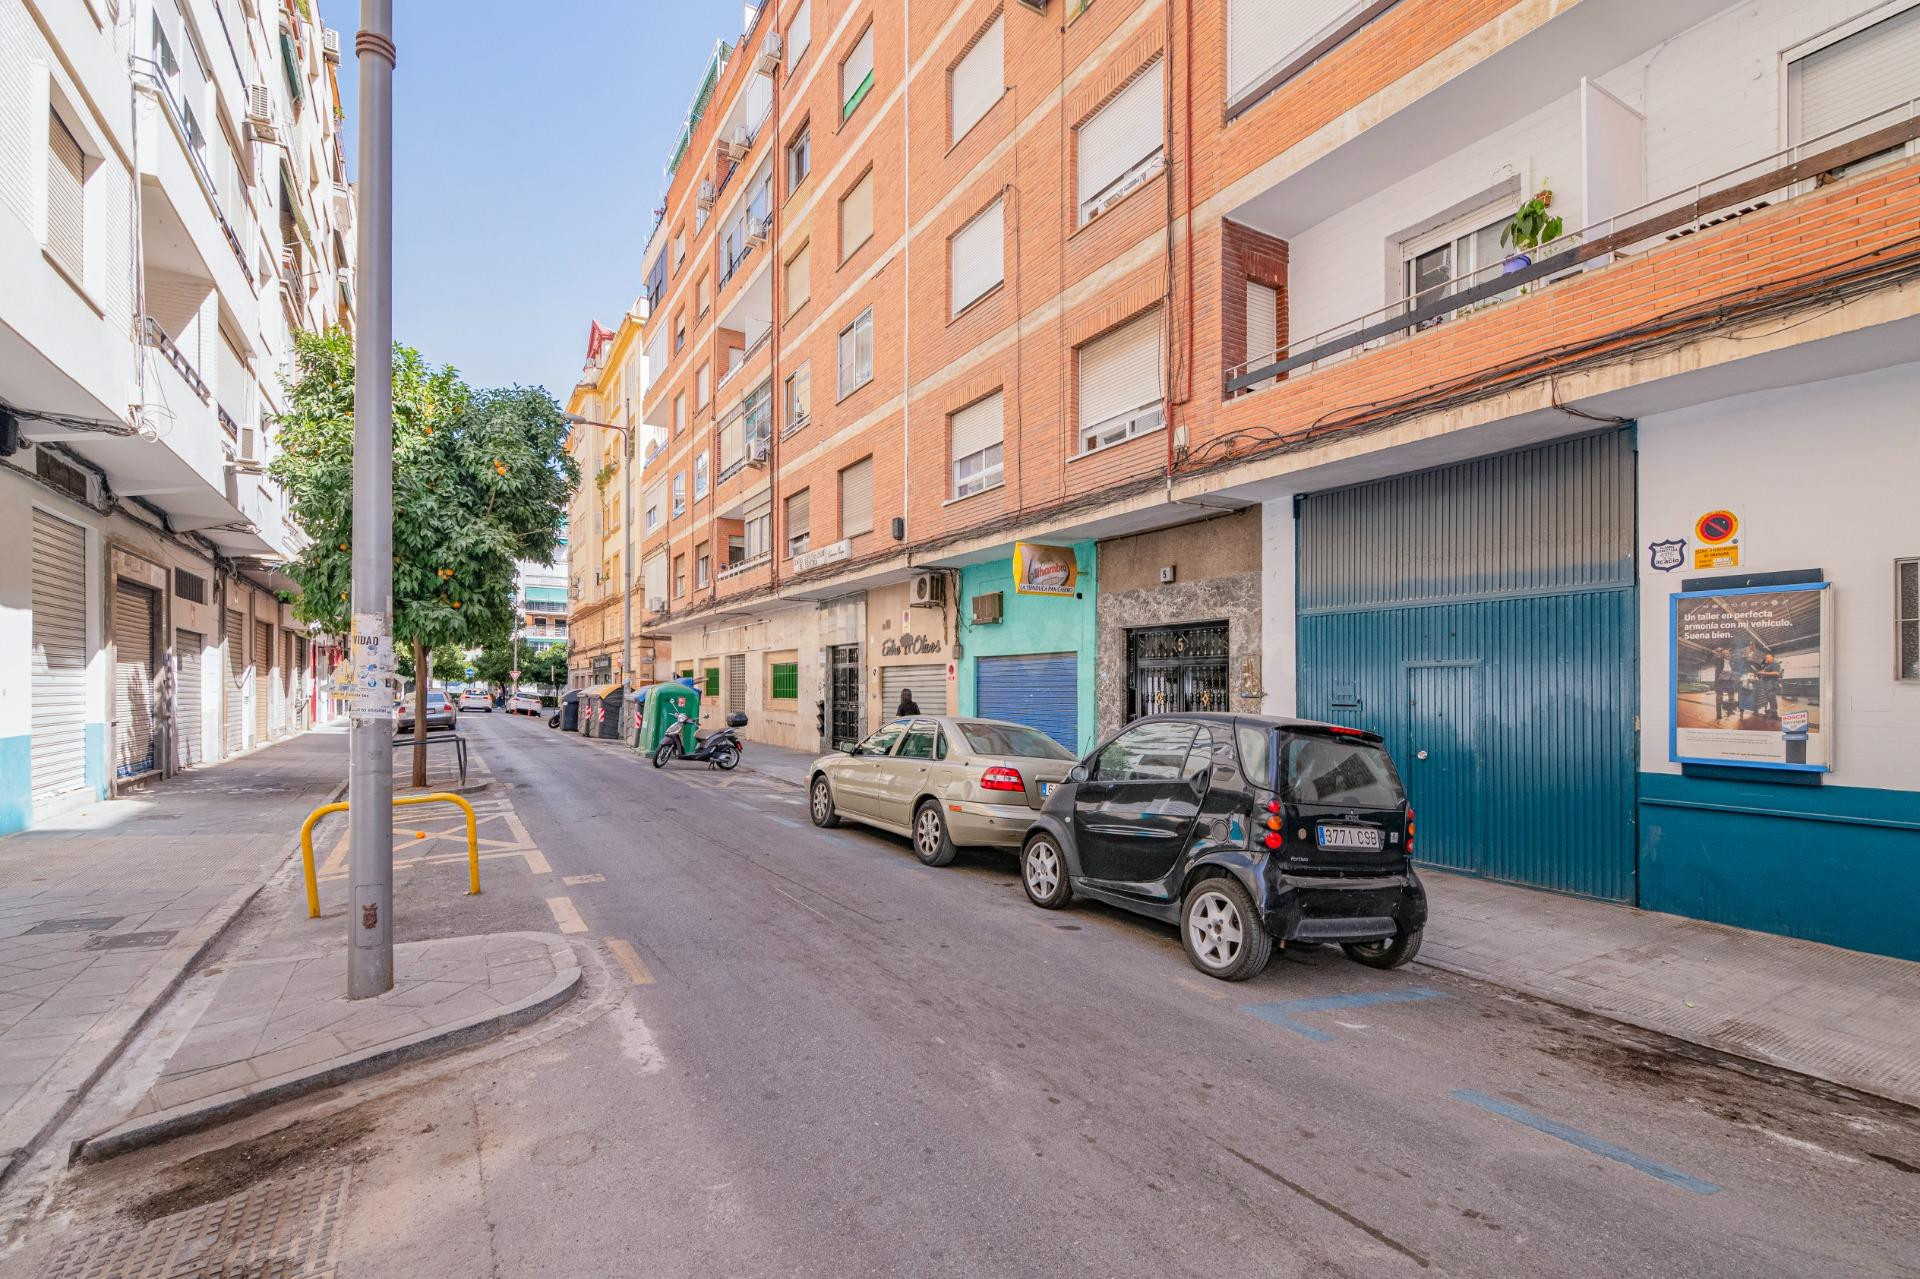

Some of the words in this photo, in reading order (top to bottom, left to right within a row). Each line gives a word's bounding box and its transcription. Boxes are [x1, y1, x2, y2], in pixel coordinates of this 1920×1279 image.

[1162, 570, 1167, 578] 5
[1684, 613, 1697, 621] Un
[1734, 610, 1773, 622] perfecta
[1684, 621, 1719, 631] armonía
[1737, 620, 1749, 628] mi
[1684, 632, 1710, 640] Suena
[1711, 631, 1734, 639] bien.
[1177, 638, 1184, 652] 5
[1325, 829, 1353, 845] 3771
